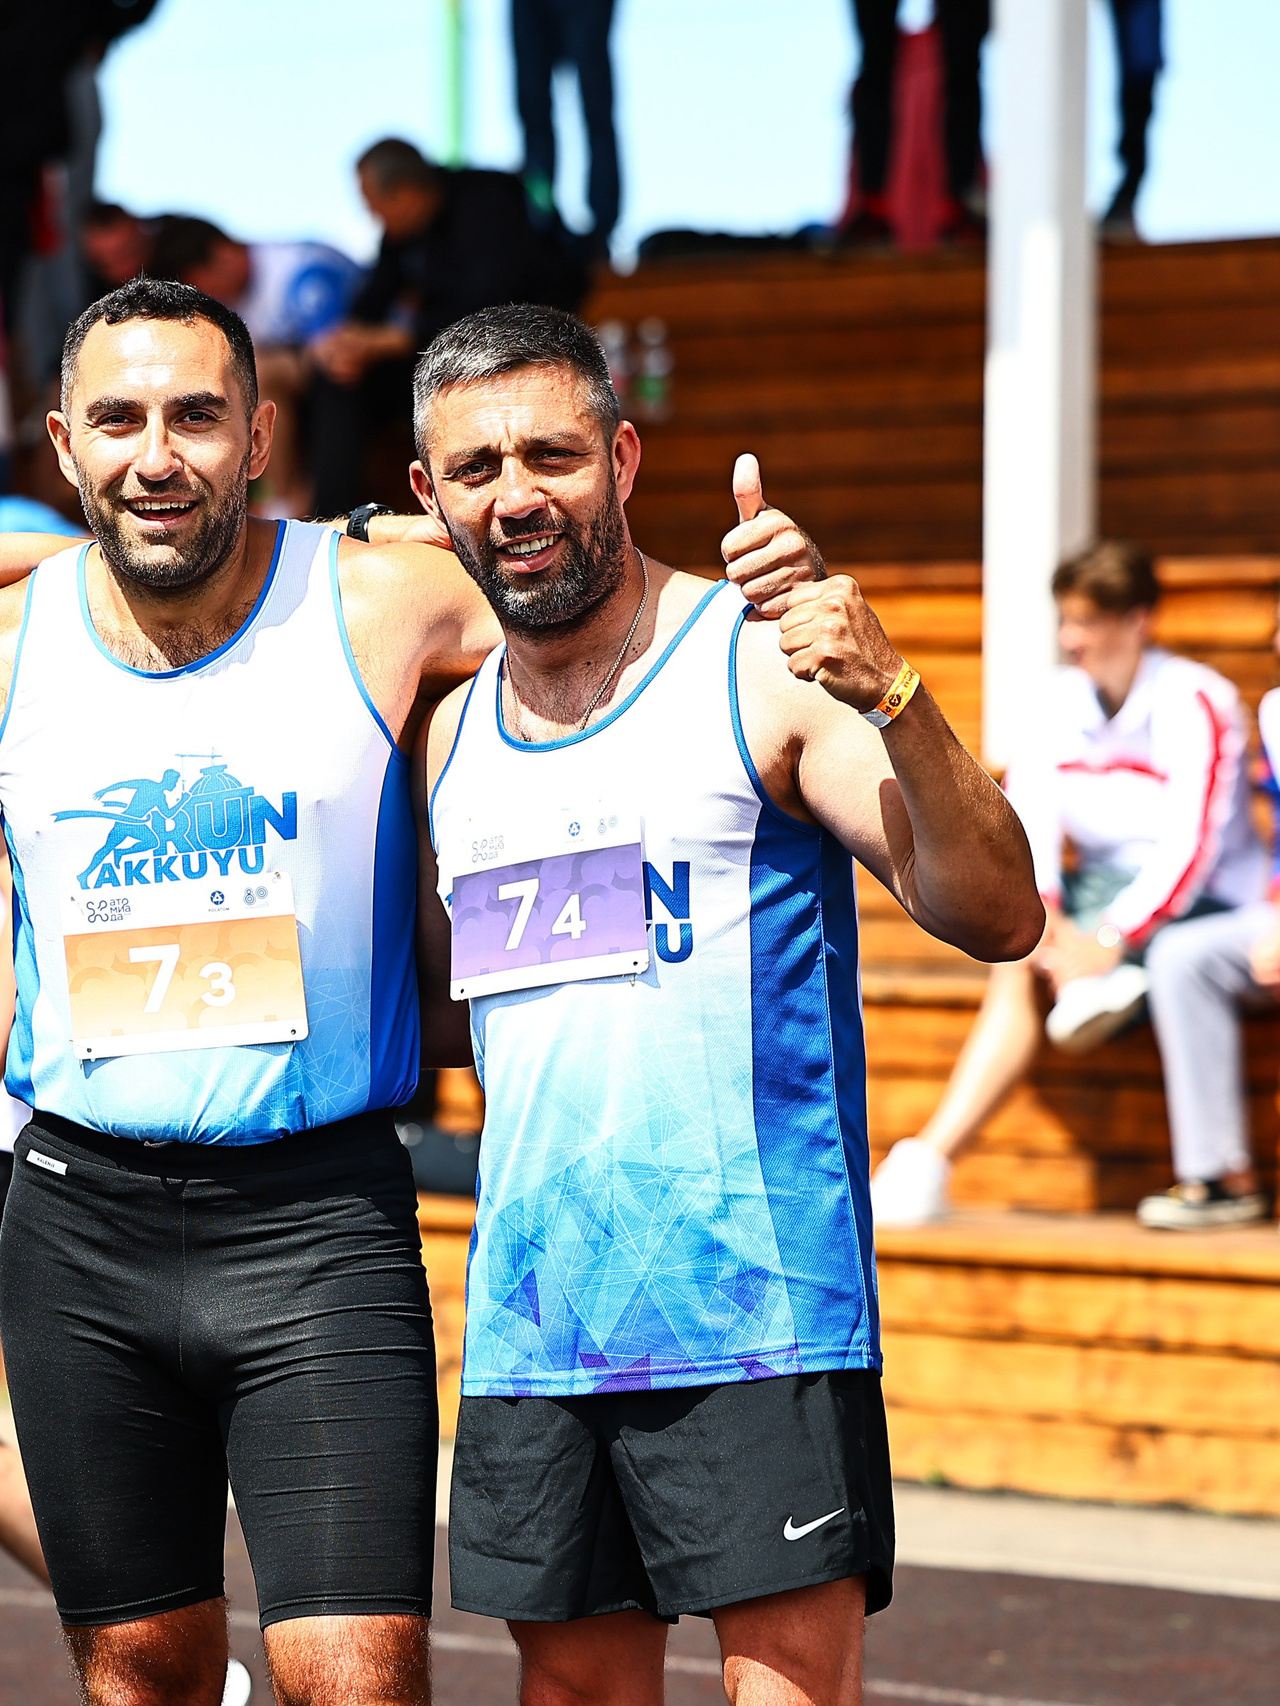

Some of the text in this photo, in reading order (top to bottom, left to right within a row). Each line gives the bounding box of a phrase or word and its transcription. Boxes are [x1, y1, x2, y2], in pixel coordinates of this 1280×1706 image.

[152, 791, 297, 856] RUN
[93, 845, 264, 889] AKKUYU
[498, 877, 587, 951] 7 4
[128, 944, 236, 1013] 7 3
